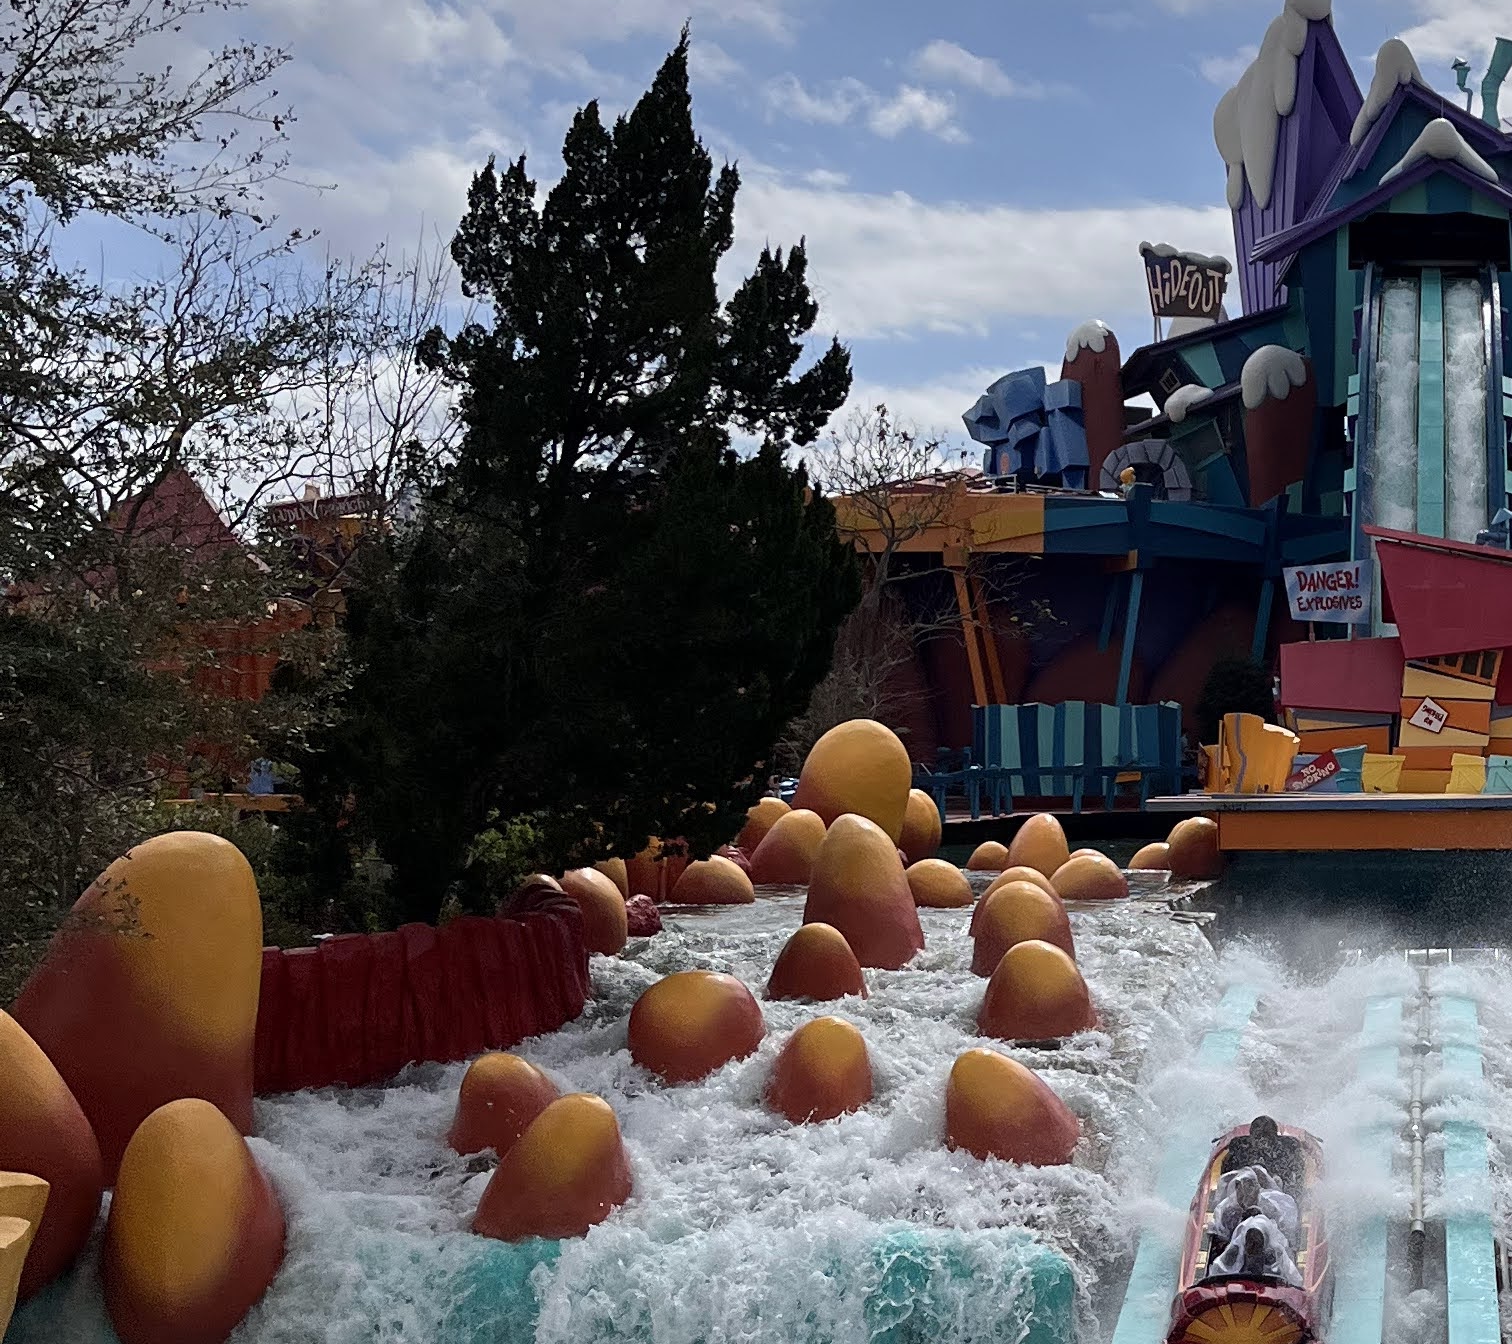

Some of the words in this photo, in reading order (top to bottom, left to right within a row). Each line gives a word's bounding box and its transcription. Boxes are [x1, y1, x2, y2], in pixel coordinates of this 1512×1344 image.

[1296, 567, 1359, 592] DANGER!
[1297, 595, 1362, 611] EXPLOSIVES
[1301, 764, 1317, 777] NO
